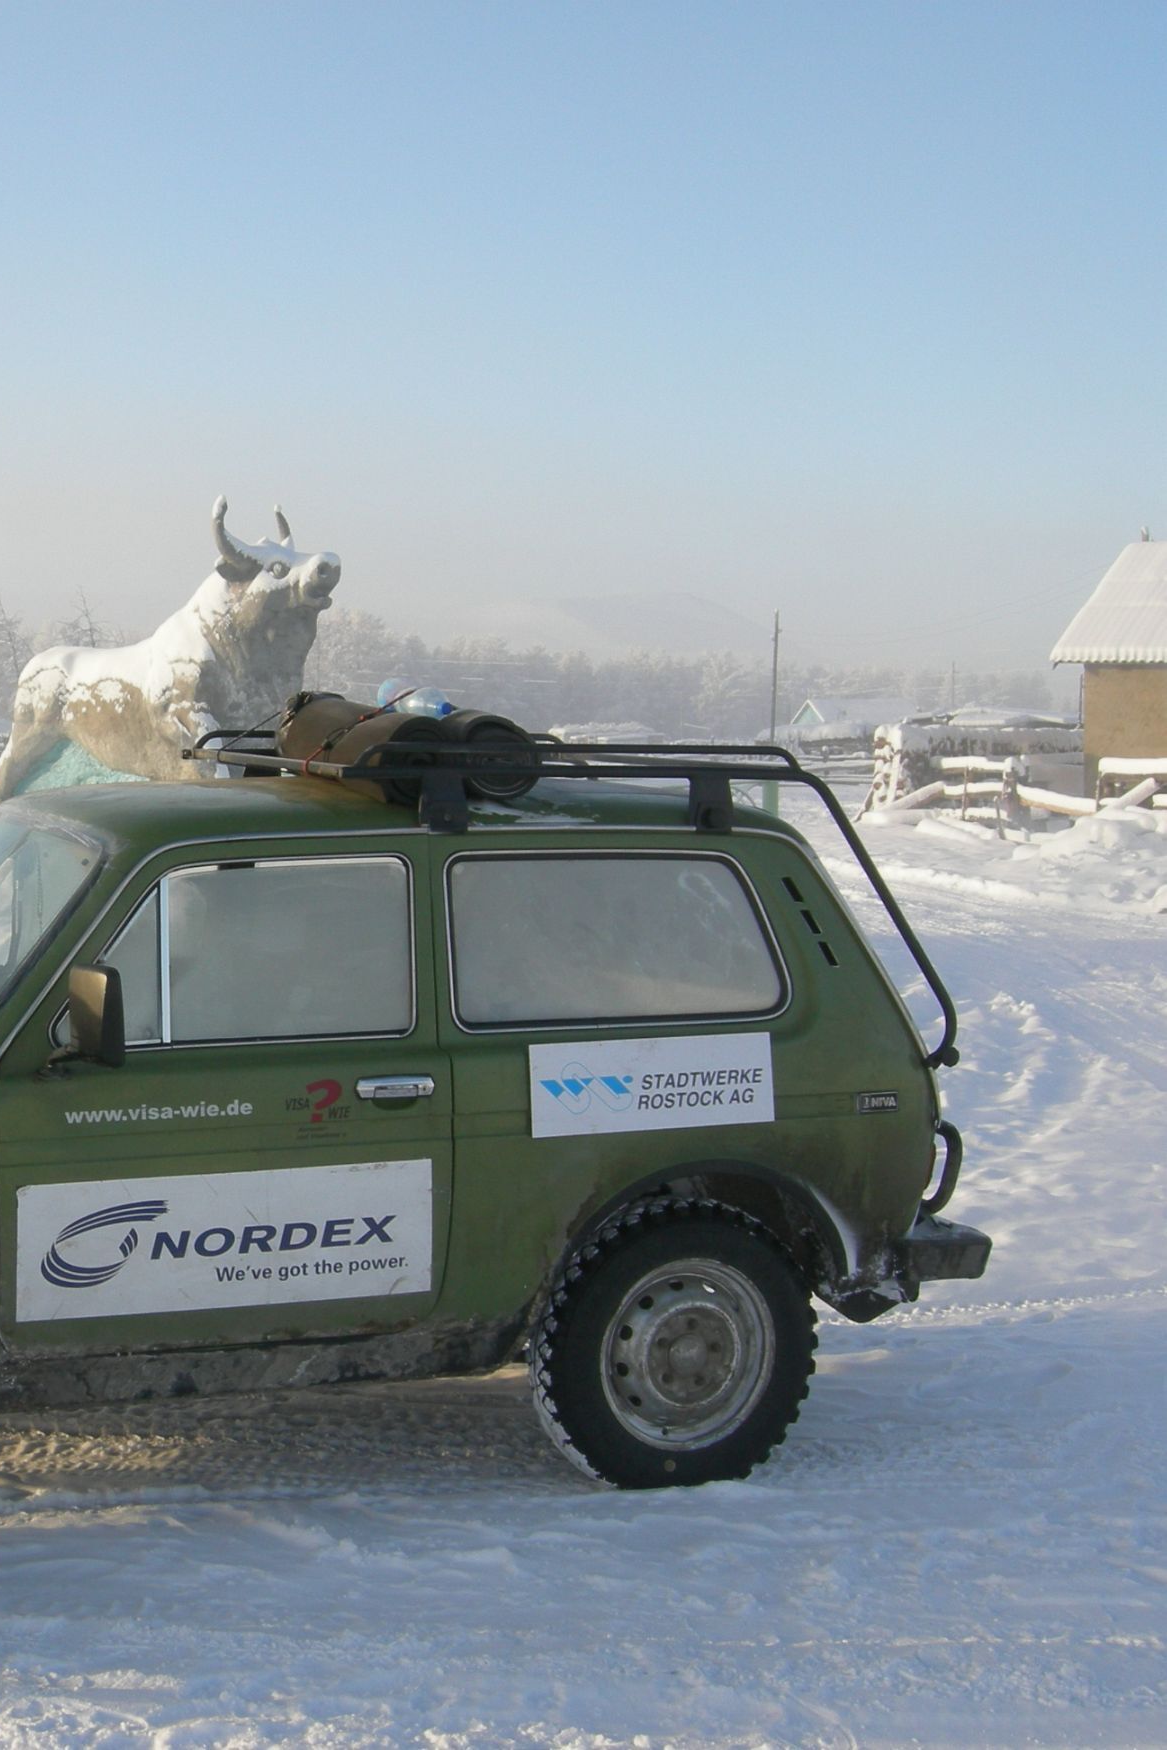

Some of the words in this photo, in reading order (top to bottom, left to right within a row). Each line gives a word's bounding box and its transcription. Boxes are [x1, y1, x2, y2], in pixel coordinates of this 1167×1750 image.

[641, 1068, 763, 1090] STADTWERKE
[637, 1089, 725, 1110] ROSTOCK
[729, 1088, 755, 1105] AG
[64, 1100, 254, 1125] www.visa-wie.de
[150, 1214, 397, 1260] NORDEX
[215, 1265, 273, 1283] We've
[277, 1262, 309, 1281] got
[313, 1259, 344, 1276] the
[348, 1255, 410, 1274] power.
